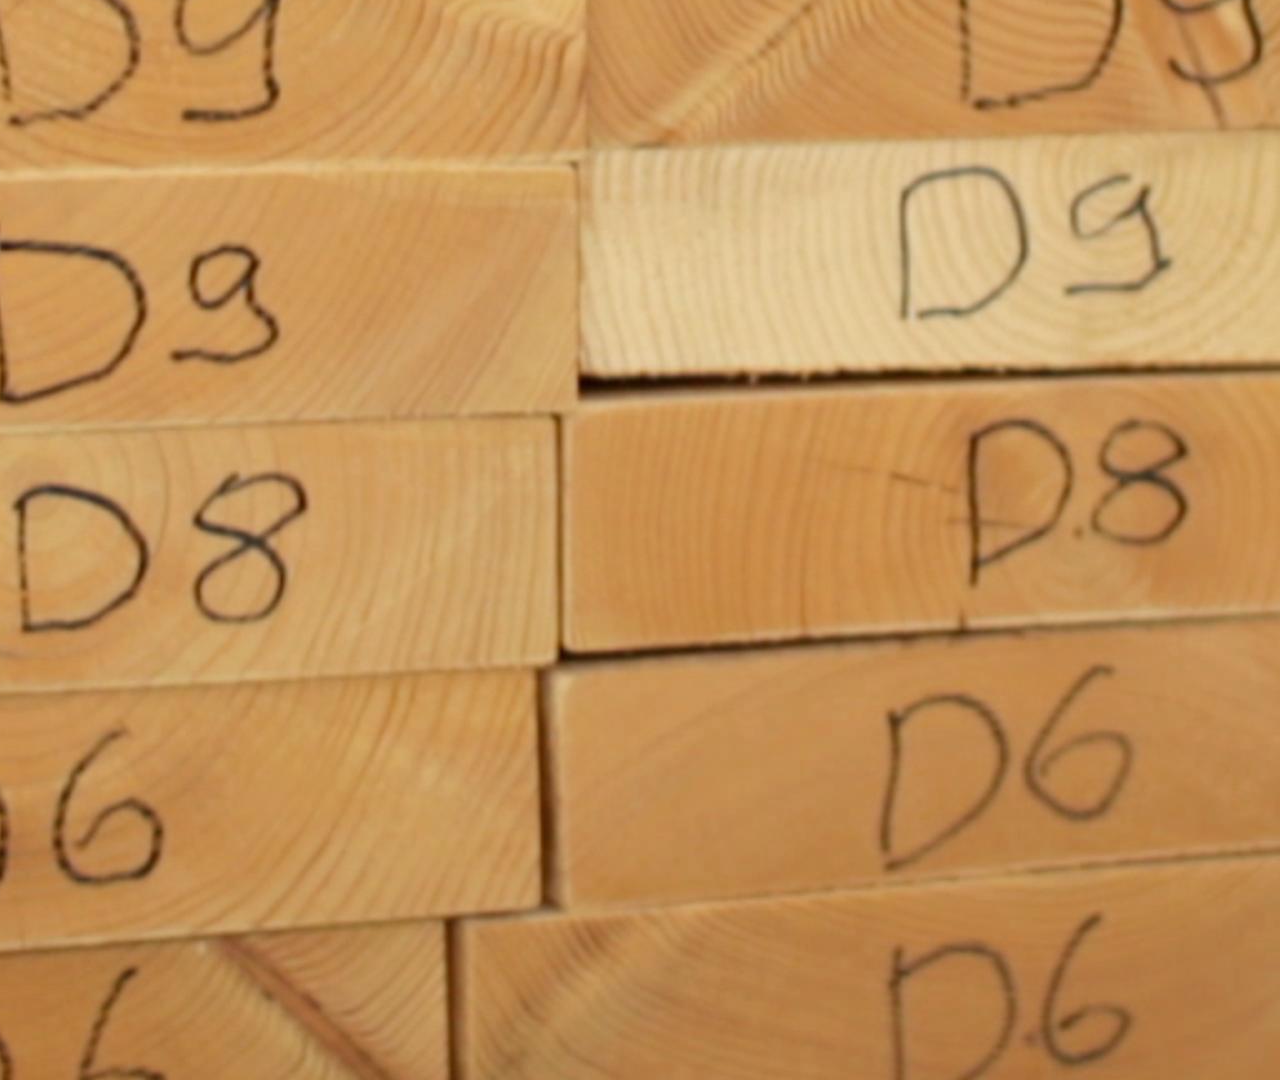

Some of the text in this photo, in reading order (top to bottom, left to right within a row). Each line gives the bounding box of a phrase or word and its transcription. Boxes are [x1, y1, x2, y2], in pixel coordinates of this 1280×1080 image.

[900, 167, 1171, 320] D9
[13, 472, 308, 633] D8
[967, 418, 1188, 586] D8
[880, 665, 1133, 872] D6
